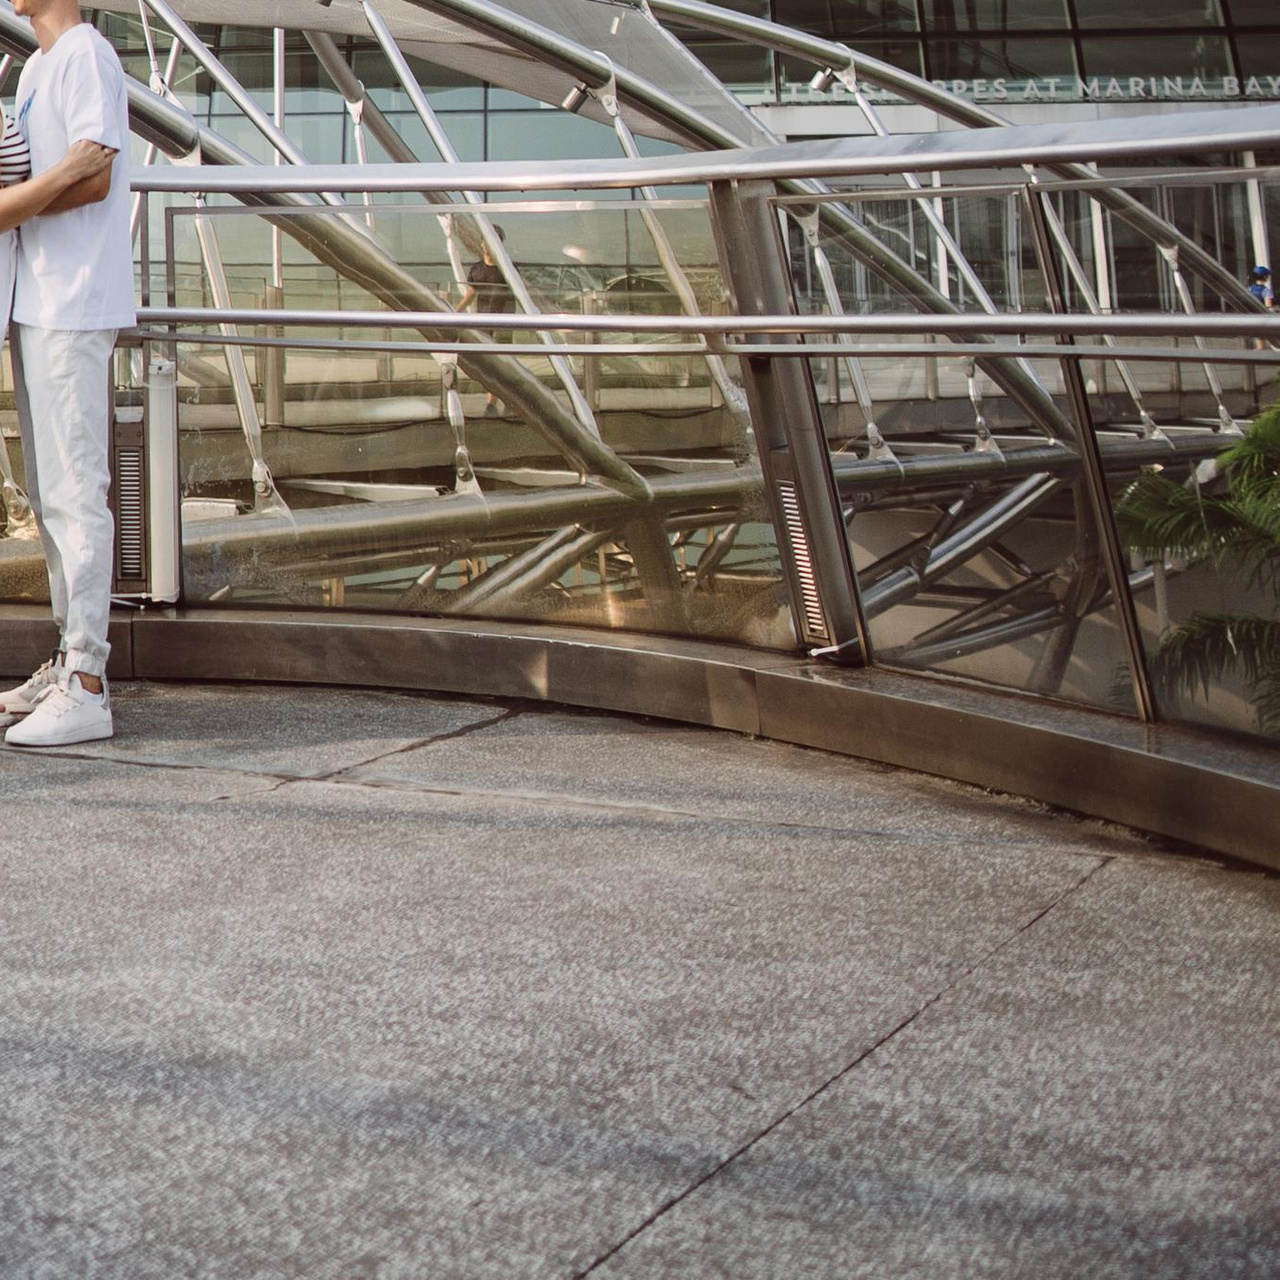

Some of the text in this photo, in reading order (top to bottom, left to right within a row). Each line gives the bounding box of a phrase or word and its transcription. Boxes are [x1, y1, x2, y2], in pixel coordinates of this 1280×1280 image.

[1024, 78, 1060, 98] AT
[1077, 76, 1207, 97] MARINA
[1223, 76, 1280, 96] BAY
